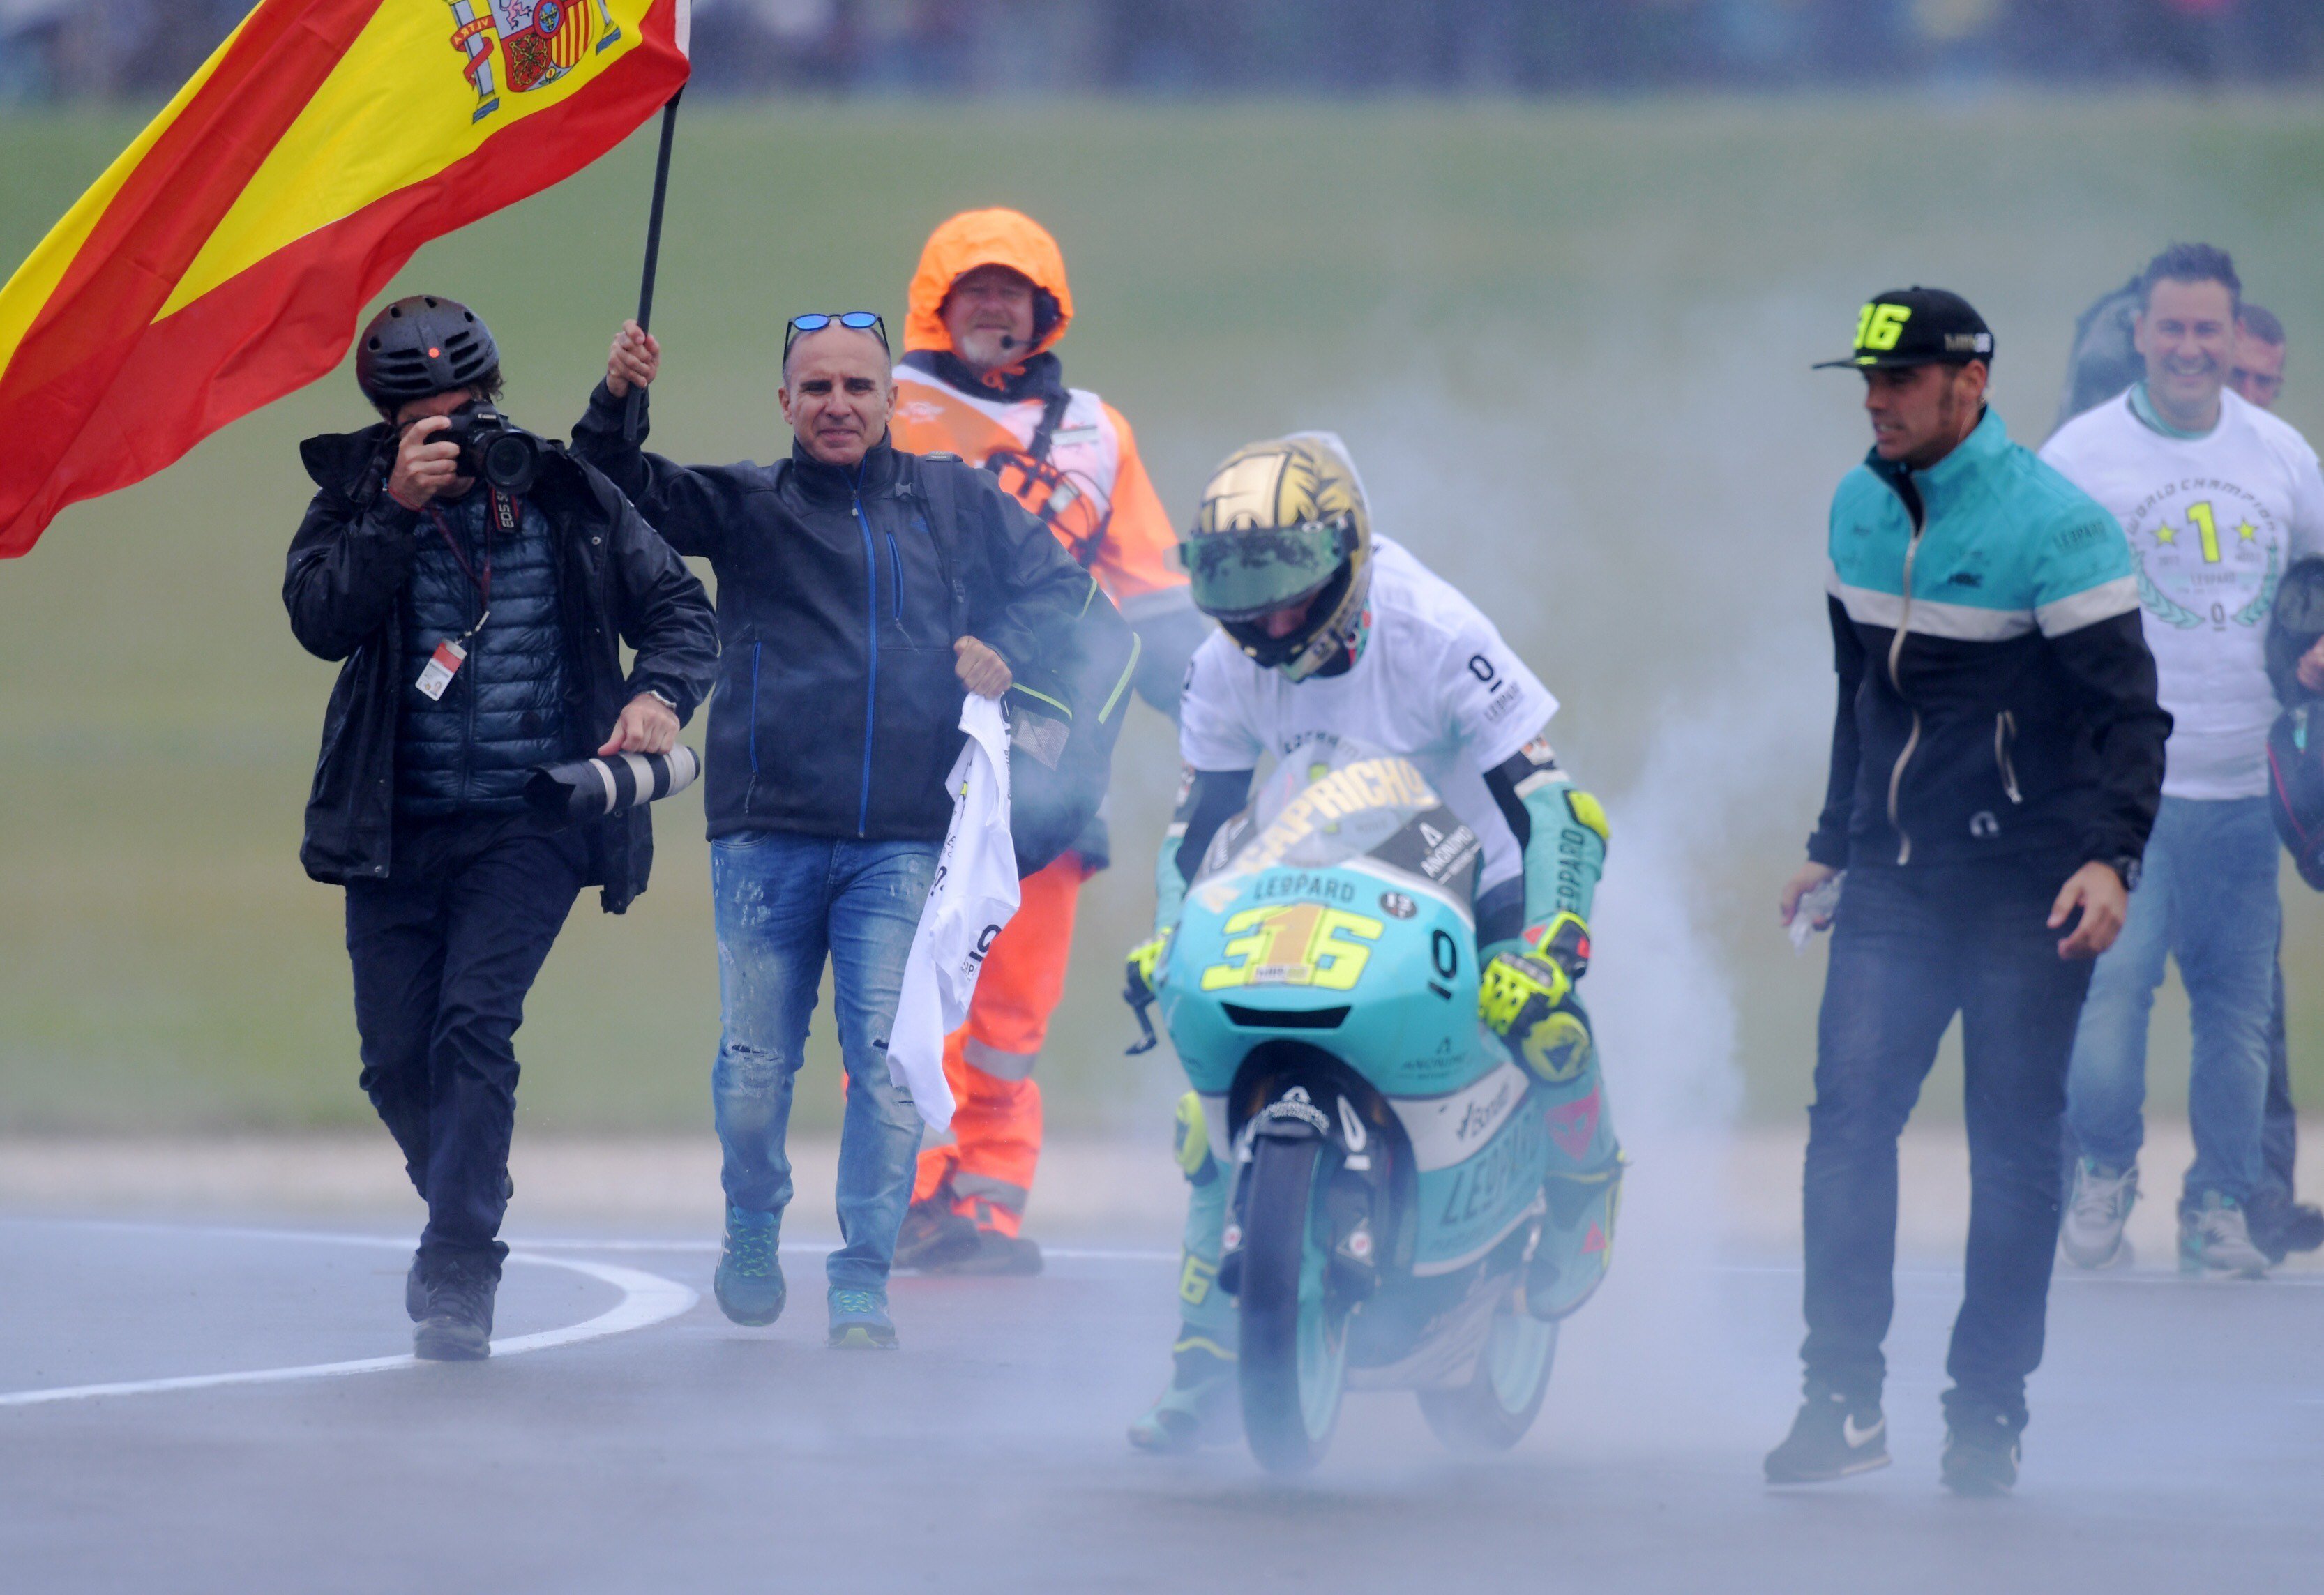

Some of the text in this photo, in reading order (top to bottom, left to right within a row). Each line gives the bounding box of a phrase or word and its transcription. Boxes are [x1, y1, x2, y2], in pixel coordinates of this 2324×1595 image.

[499, 504, 514, 529] EOS
[2185, 500, 2221, 564] 1
[1254, 872, 1355, 902] LEOPARD
